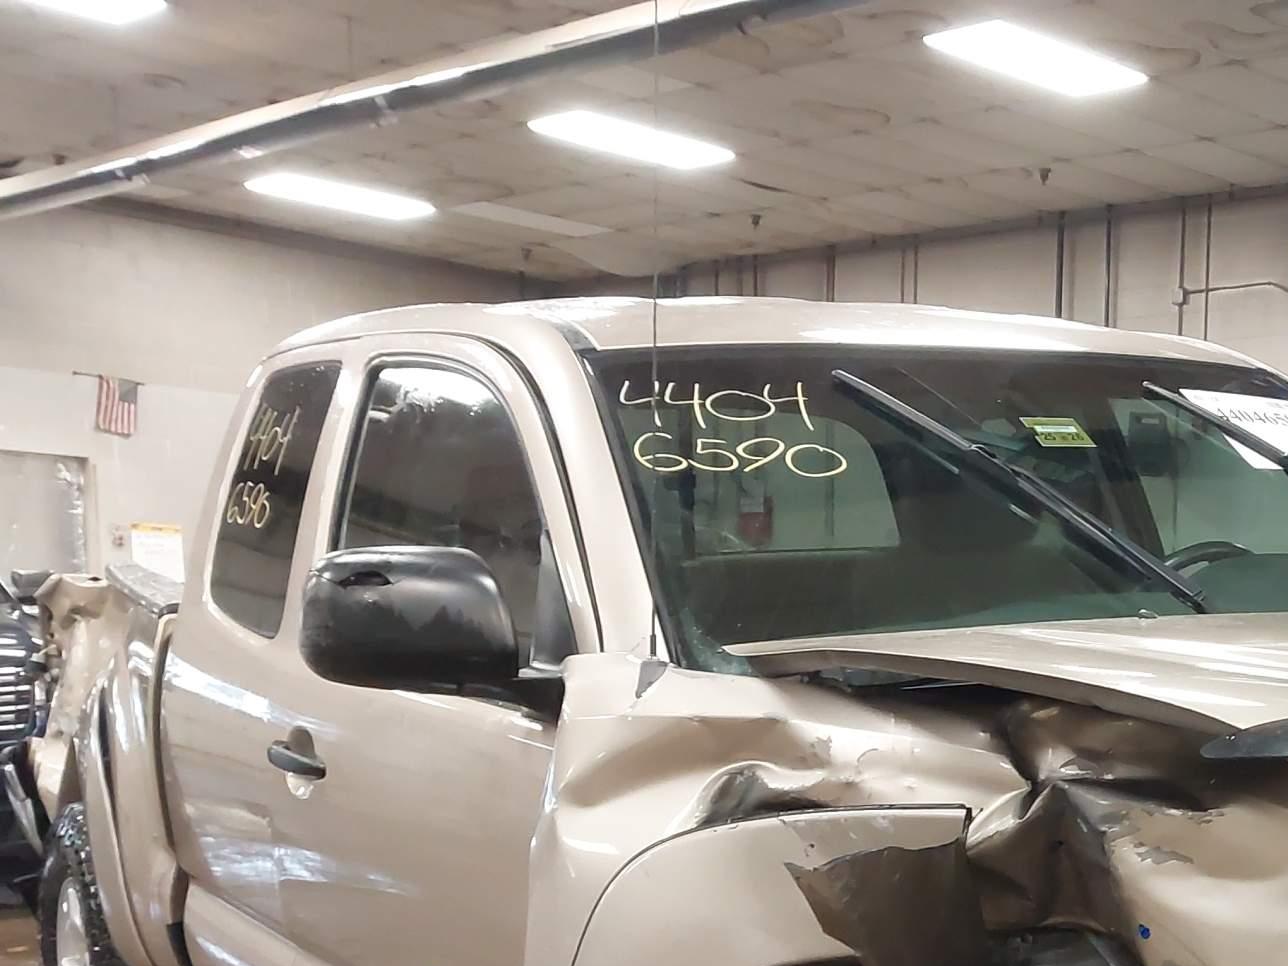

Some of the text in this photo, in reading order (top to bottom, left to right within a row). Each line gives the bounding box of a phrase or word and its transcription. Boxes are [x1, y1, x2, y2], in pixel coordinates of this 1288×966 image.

[619, 380, 814, 431] 4404
[243, 403, 301, 476] 4404
[633, 431, 848, 478] 6590
